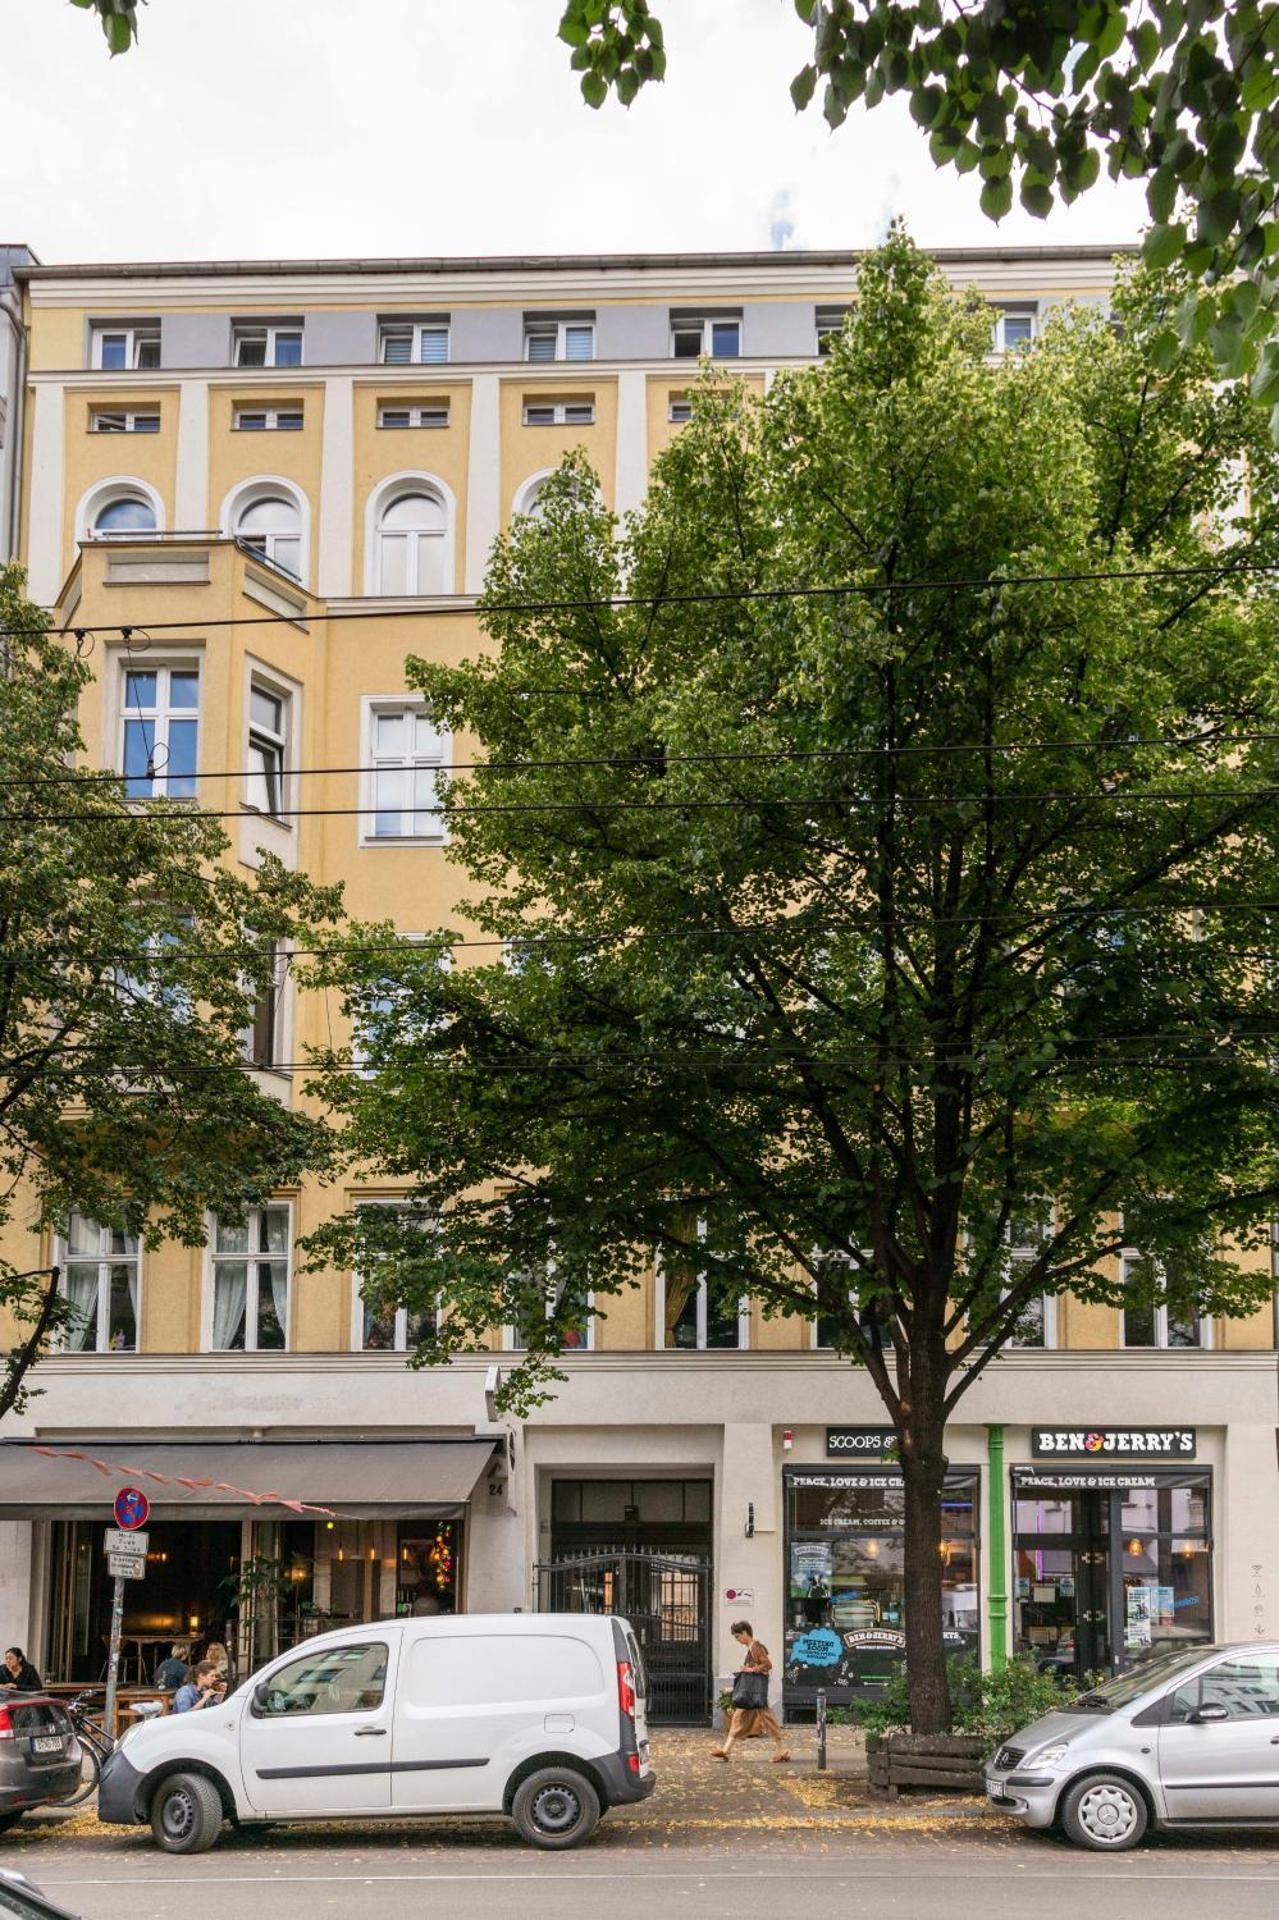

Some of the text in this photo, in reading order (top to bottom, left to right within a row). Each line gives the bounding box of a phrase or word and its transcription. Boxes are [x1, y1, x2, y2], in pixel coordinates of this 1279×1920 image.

[829, 1436, 881, 1449] SCOOPS
[793, 1477, 829, 1487] PEACE,
[831, 1477, 858, 1487] LOVE
[859, 1478, 868, 1487] &
[870, 1477, 887, 1487] ICE
[1020, 1476, 1156, 1487] PEACE, LOVE & ICE CREAM
[489, 1484, 503, 1496] 24
